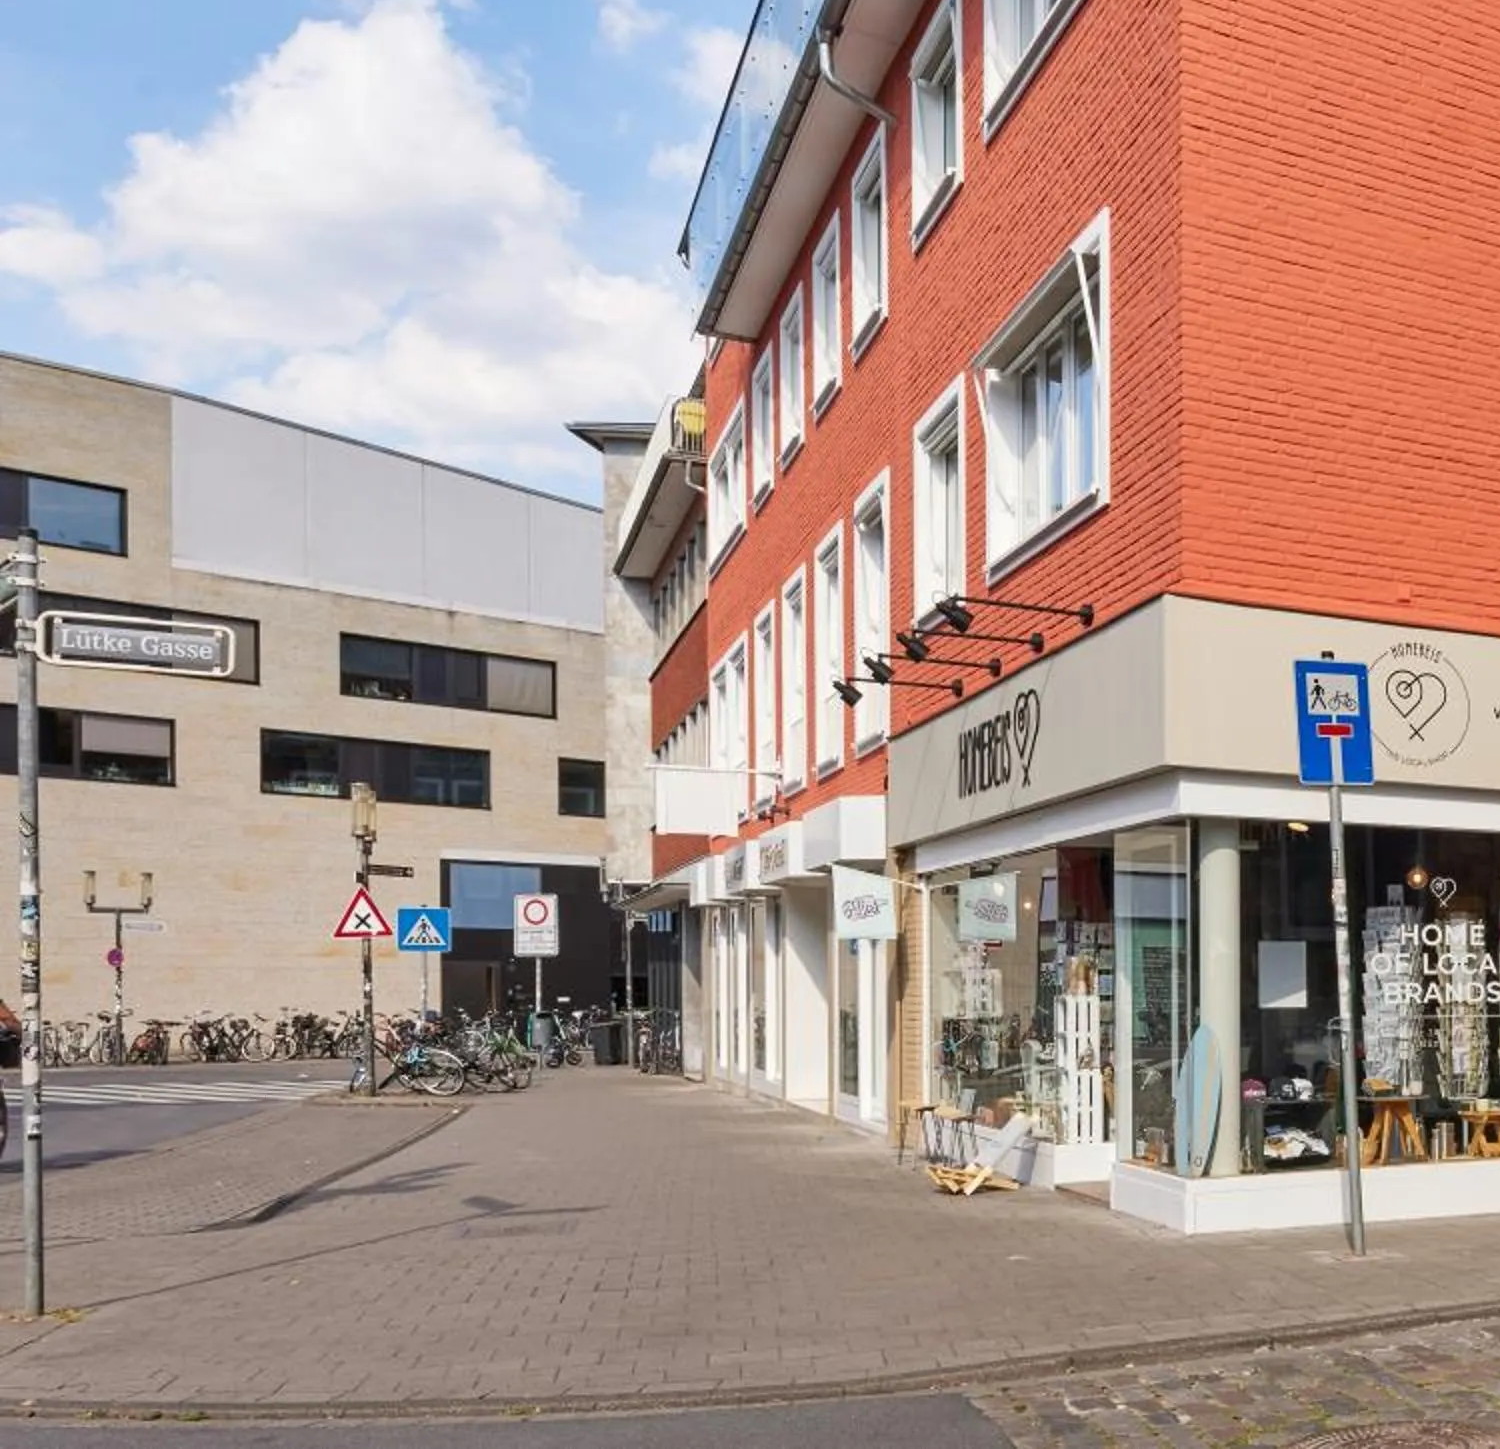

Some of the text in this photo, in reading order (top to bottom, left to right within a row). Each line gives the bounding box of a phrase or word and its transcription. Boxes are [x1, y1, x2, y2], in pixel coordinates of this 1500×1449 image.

[61, 628, 213, 660] Lütke Gasse
[1400, 923, 1485, 946] HOME
[1371, 952, 1412, 975] OF
